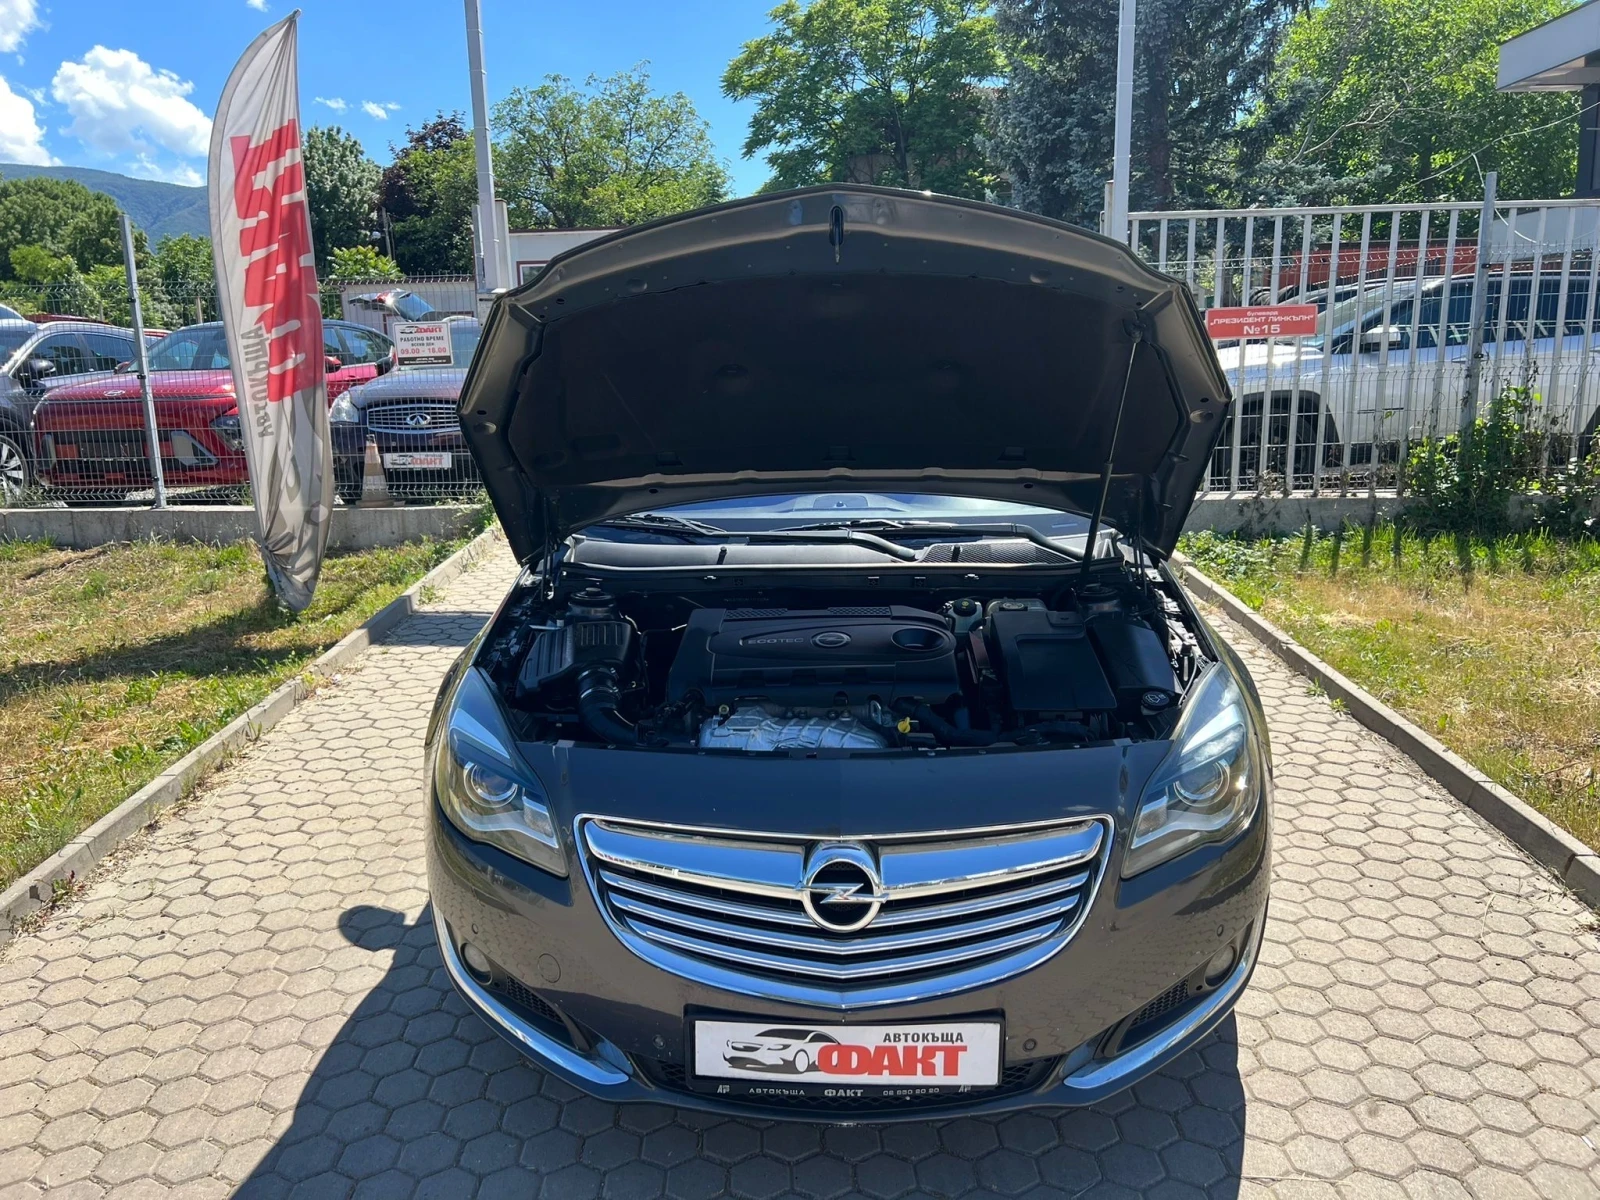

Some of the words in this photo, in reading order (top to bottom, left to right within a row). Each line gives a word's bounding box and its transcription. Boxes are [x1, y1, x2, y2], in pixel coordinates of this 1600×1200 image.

[1243, 324, 1281, 335] №15
[428, 346, 447, 354] 18.00
[241, 325, 274, 440] АВТОКЪЩА
[747, 637, 804, 645] ECOTEC
[883, 1032, 964, 1045] АВТОКЪЩА
[818, 1044, 968, 1076] ФАКТ
[824, 1088, 864, 1097] ФАКТ
